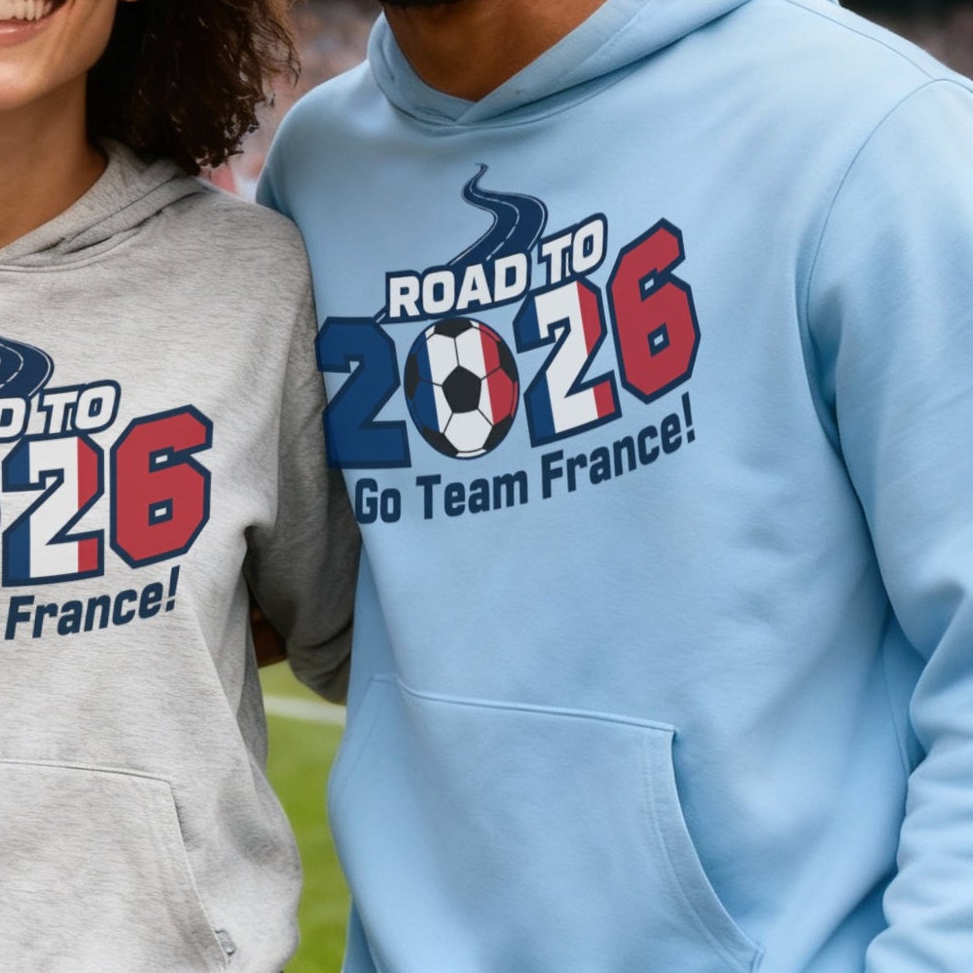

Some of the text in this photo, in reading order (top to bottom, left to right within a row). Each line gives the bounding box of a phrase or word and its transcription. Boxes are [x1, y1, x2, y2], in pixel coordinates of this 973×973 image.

[387, 215, 607, 321] ROAD TO
[314, 217, 701, 469] 2026
[41, 381, 120, 436] TO
[354, 391, 696, 525] Go Team France!
[4, 565, 181, 641] France!
